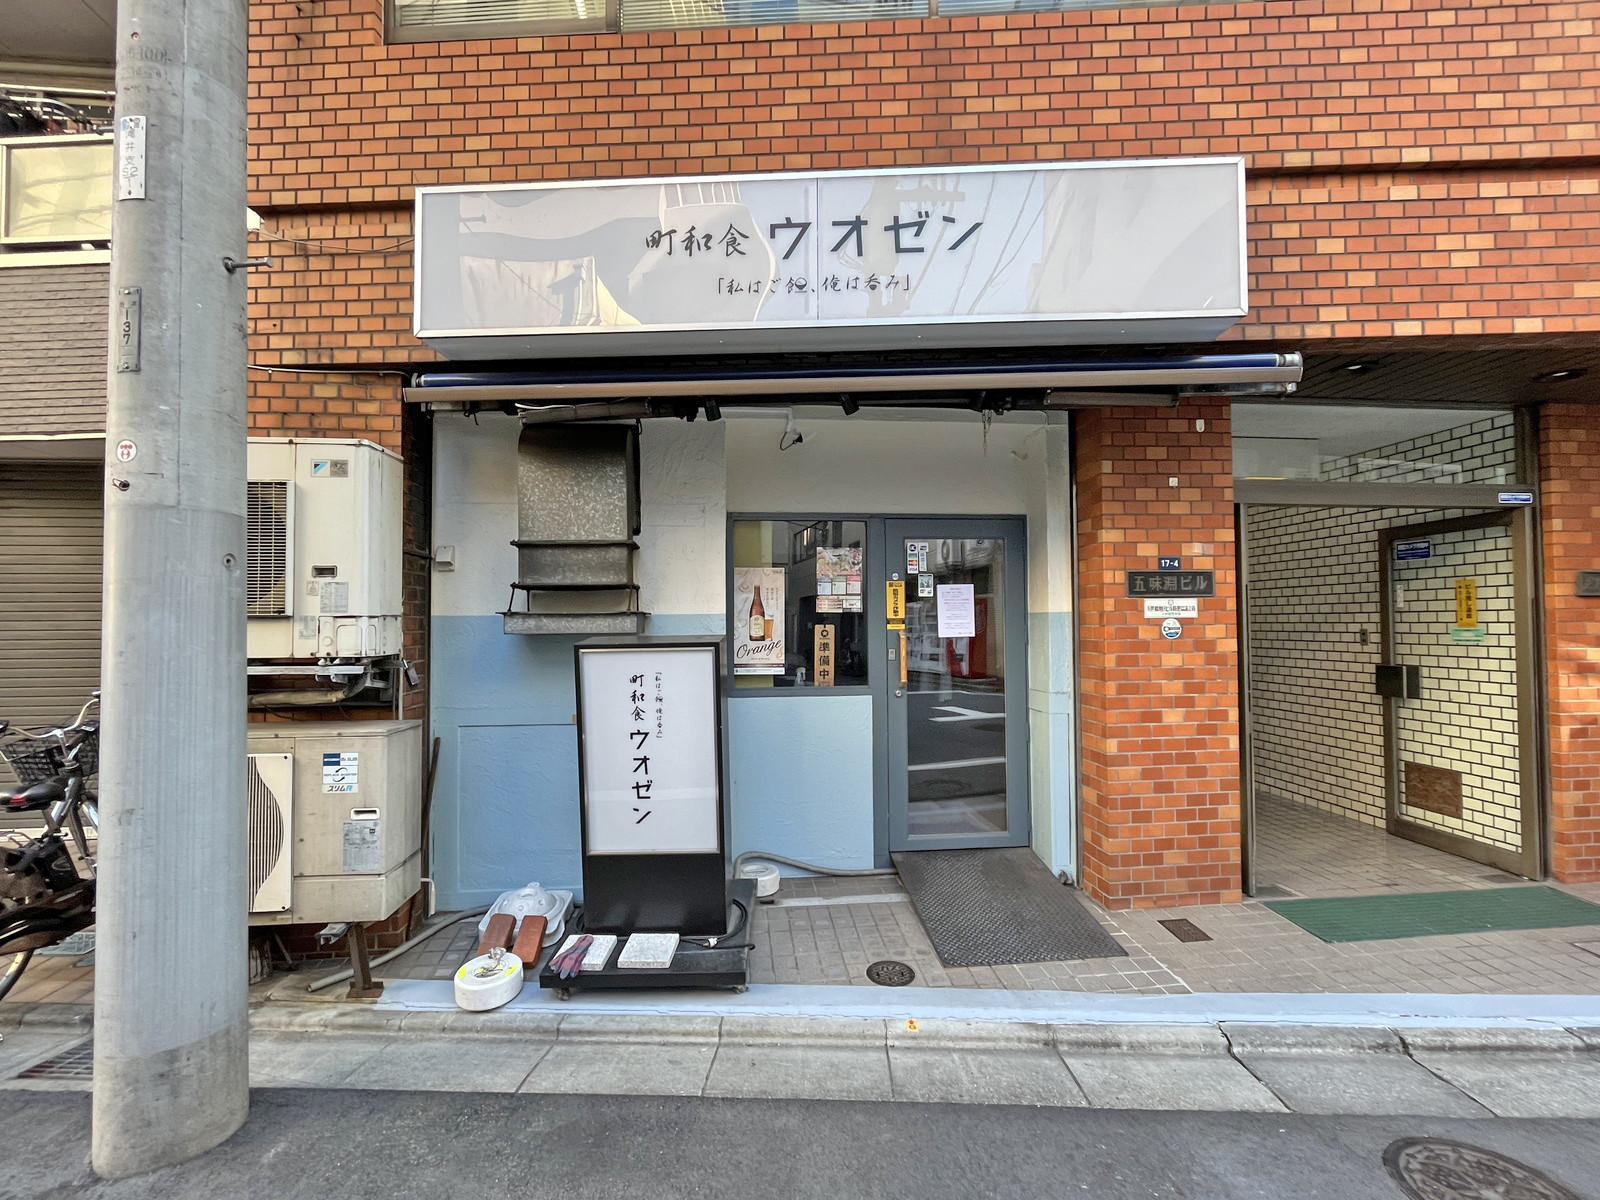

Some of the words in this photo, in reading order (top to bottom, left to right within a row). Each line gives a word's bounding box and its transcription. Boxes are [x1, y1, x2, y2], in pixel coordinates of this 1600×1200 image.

[645, 223, 750, 258] 町和食
[769, 210, 984, 260] ウオゼン
[1160, 559, 1179, 568] 17-4
[736, 640, 782, 659] Orange
[819, 641, 830, 680] 準備中
[629, 674, 646, 722] 町和食
[629, 729, 653, 825] ウオゼン
